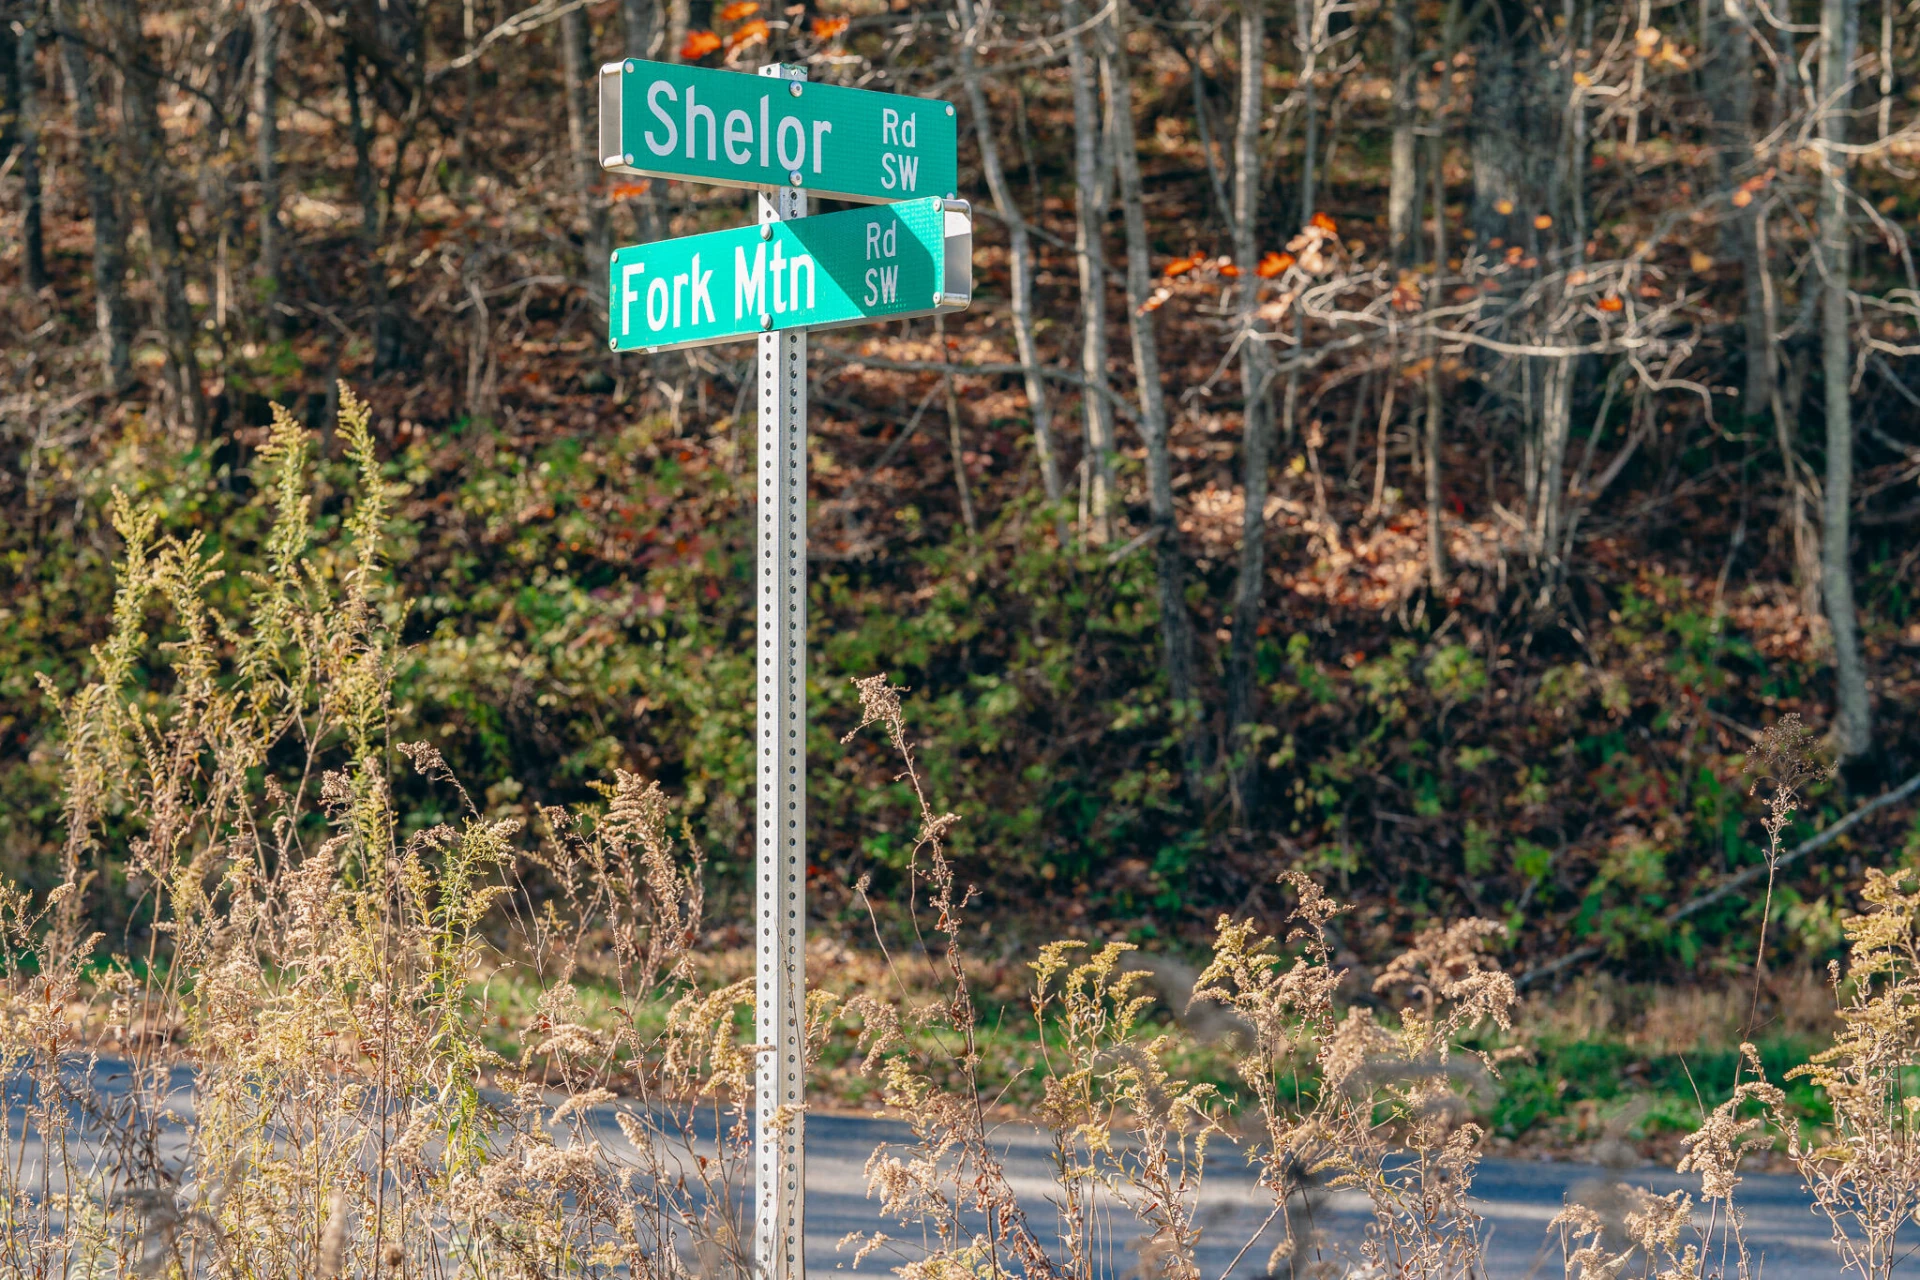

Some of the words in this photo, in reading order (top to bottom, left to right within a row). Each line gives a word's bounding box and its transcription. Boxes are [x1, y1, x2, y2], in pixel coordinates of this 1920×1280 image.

[644, 80, 832, 174] Shelor
[882, 108, 916, 148] Rd
[880, 152, 918, 192] SW
[866, 219, 897, 260] Rd
[621, 253, 716, 336] Fork
[734, 239, 816, 320] Mtn
[864, 265, 899, 307] SW
